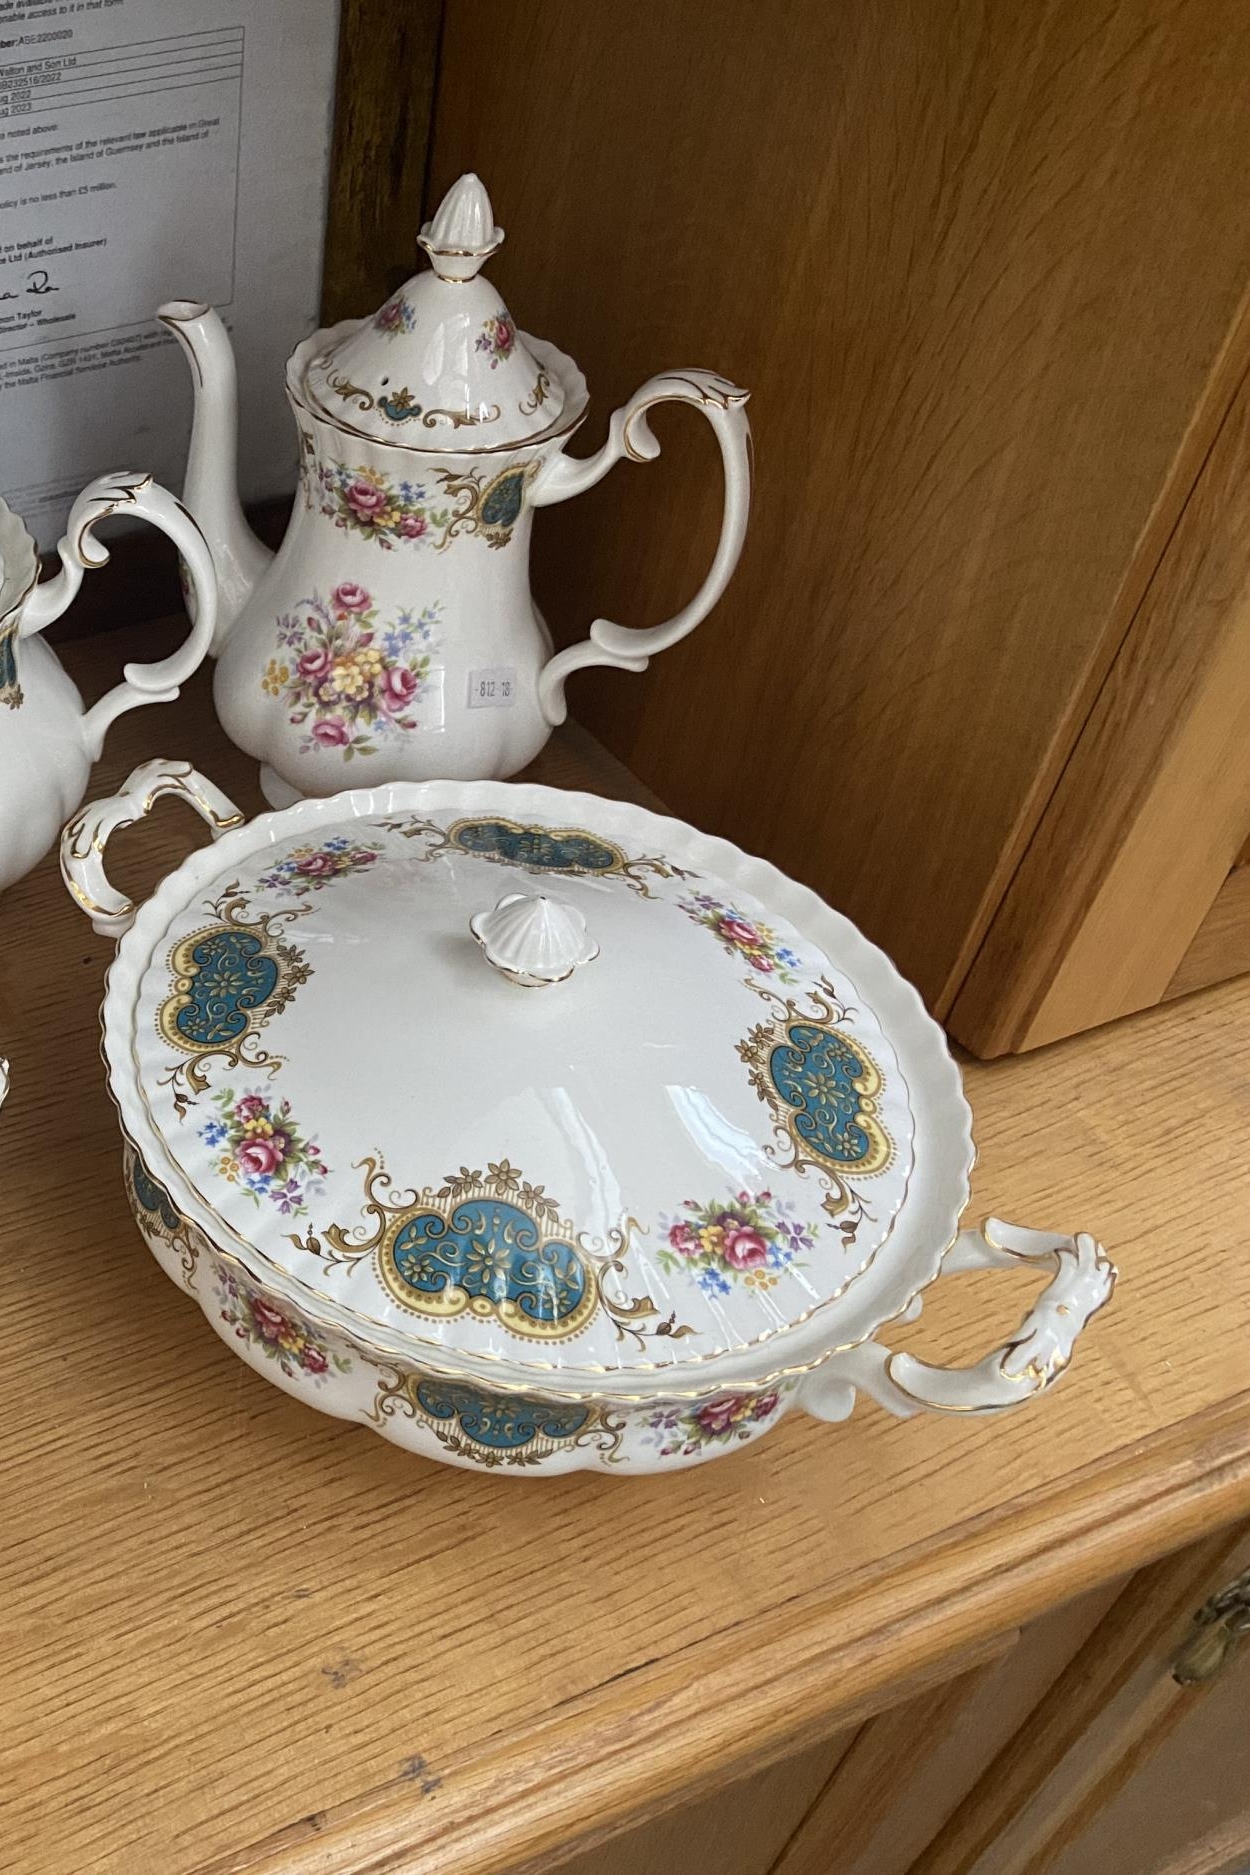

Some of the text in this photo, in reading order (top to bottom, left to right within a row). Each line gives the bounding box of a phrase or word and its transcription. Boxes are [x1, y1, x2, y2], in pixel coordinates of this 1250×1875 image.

[27, 63, 43, 73] and
[45, 60, 61, 71] Son
[7, 128, 31, 139] noted
[6, 153, 19, 163] the
[85, 139, 98, 149] the
[14, 163, 23, 172] of
[55, 156, 68, 166] the
[69, 151, 95, 163] Island
[96, 149, 104, 158] of
[145, 139, 161, 150] and
[162, 137, 175, 147] the
[176, 132, 200, 143] Island
[28, 195, 39, 204] no
[4, 244, 15, 253] on
[17, 237, 44, 250] behalf
[45, 236, 54, 246] of
[8, 253, 23, 264] Ltd
[17, 309, 43, 322] Taylor
[480, 681, 495, 697] 812
